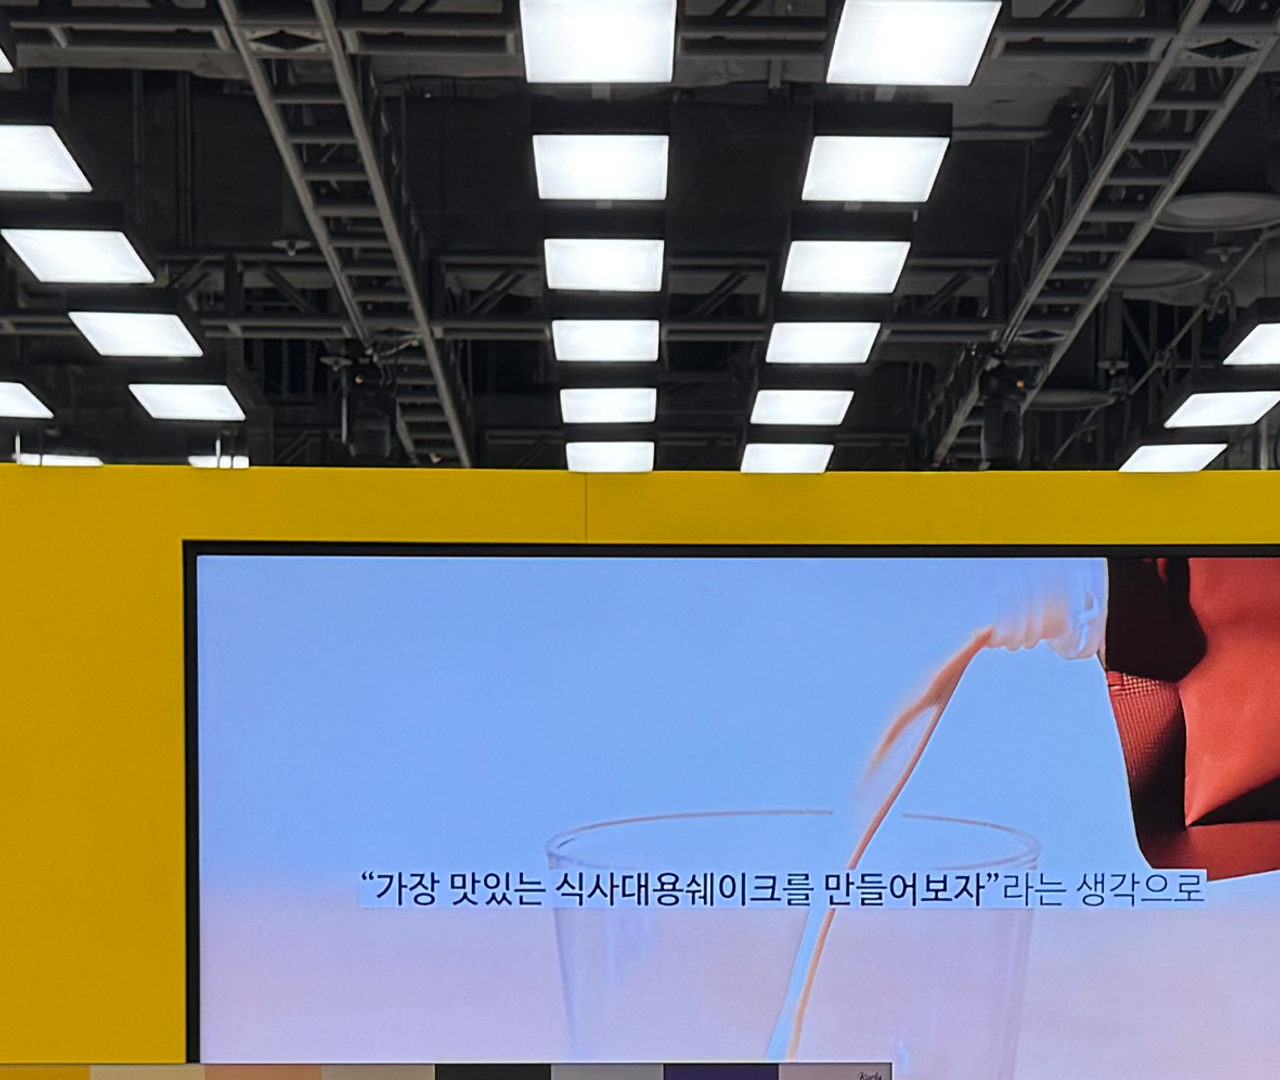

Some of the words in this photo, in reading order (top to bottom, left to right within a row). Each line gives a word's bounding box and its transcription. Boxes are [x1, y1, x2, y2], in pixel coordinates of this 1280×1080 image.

[361, 871, 440, 907] “가장
[450, 871, 547, 907] 맛있는
[555, 871, 814, 907] 식사대용쉐이크를
[824, 871, 1067, 907] 만들어보자”라는
[1076, 871, 1206, 907] 생각으로
